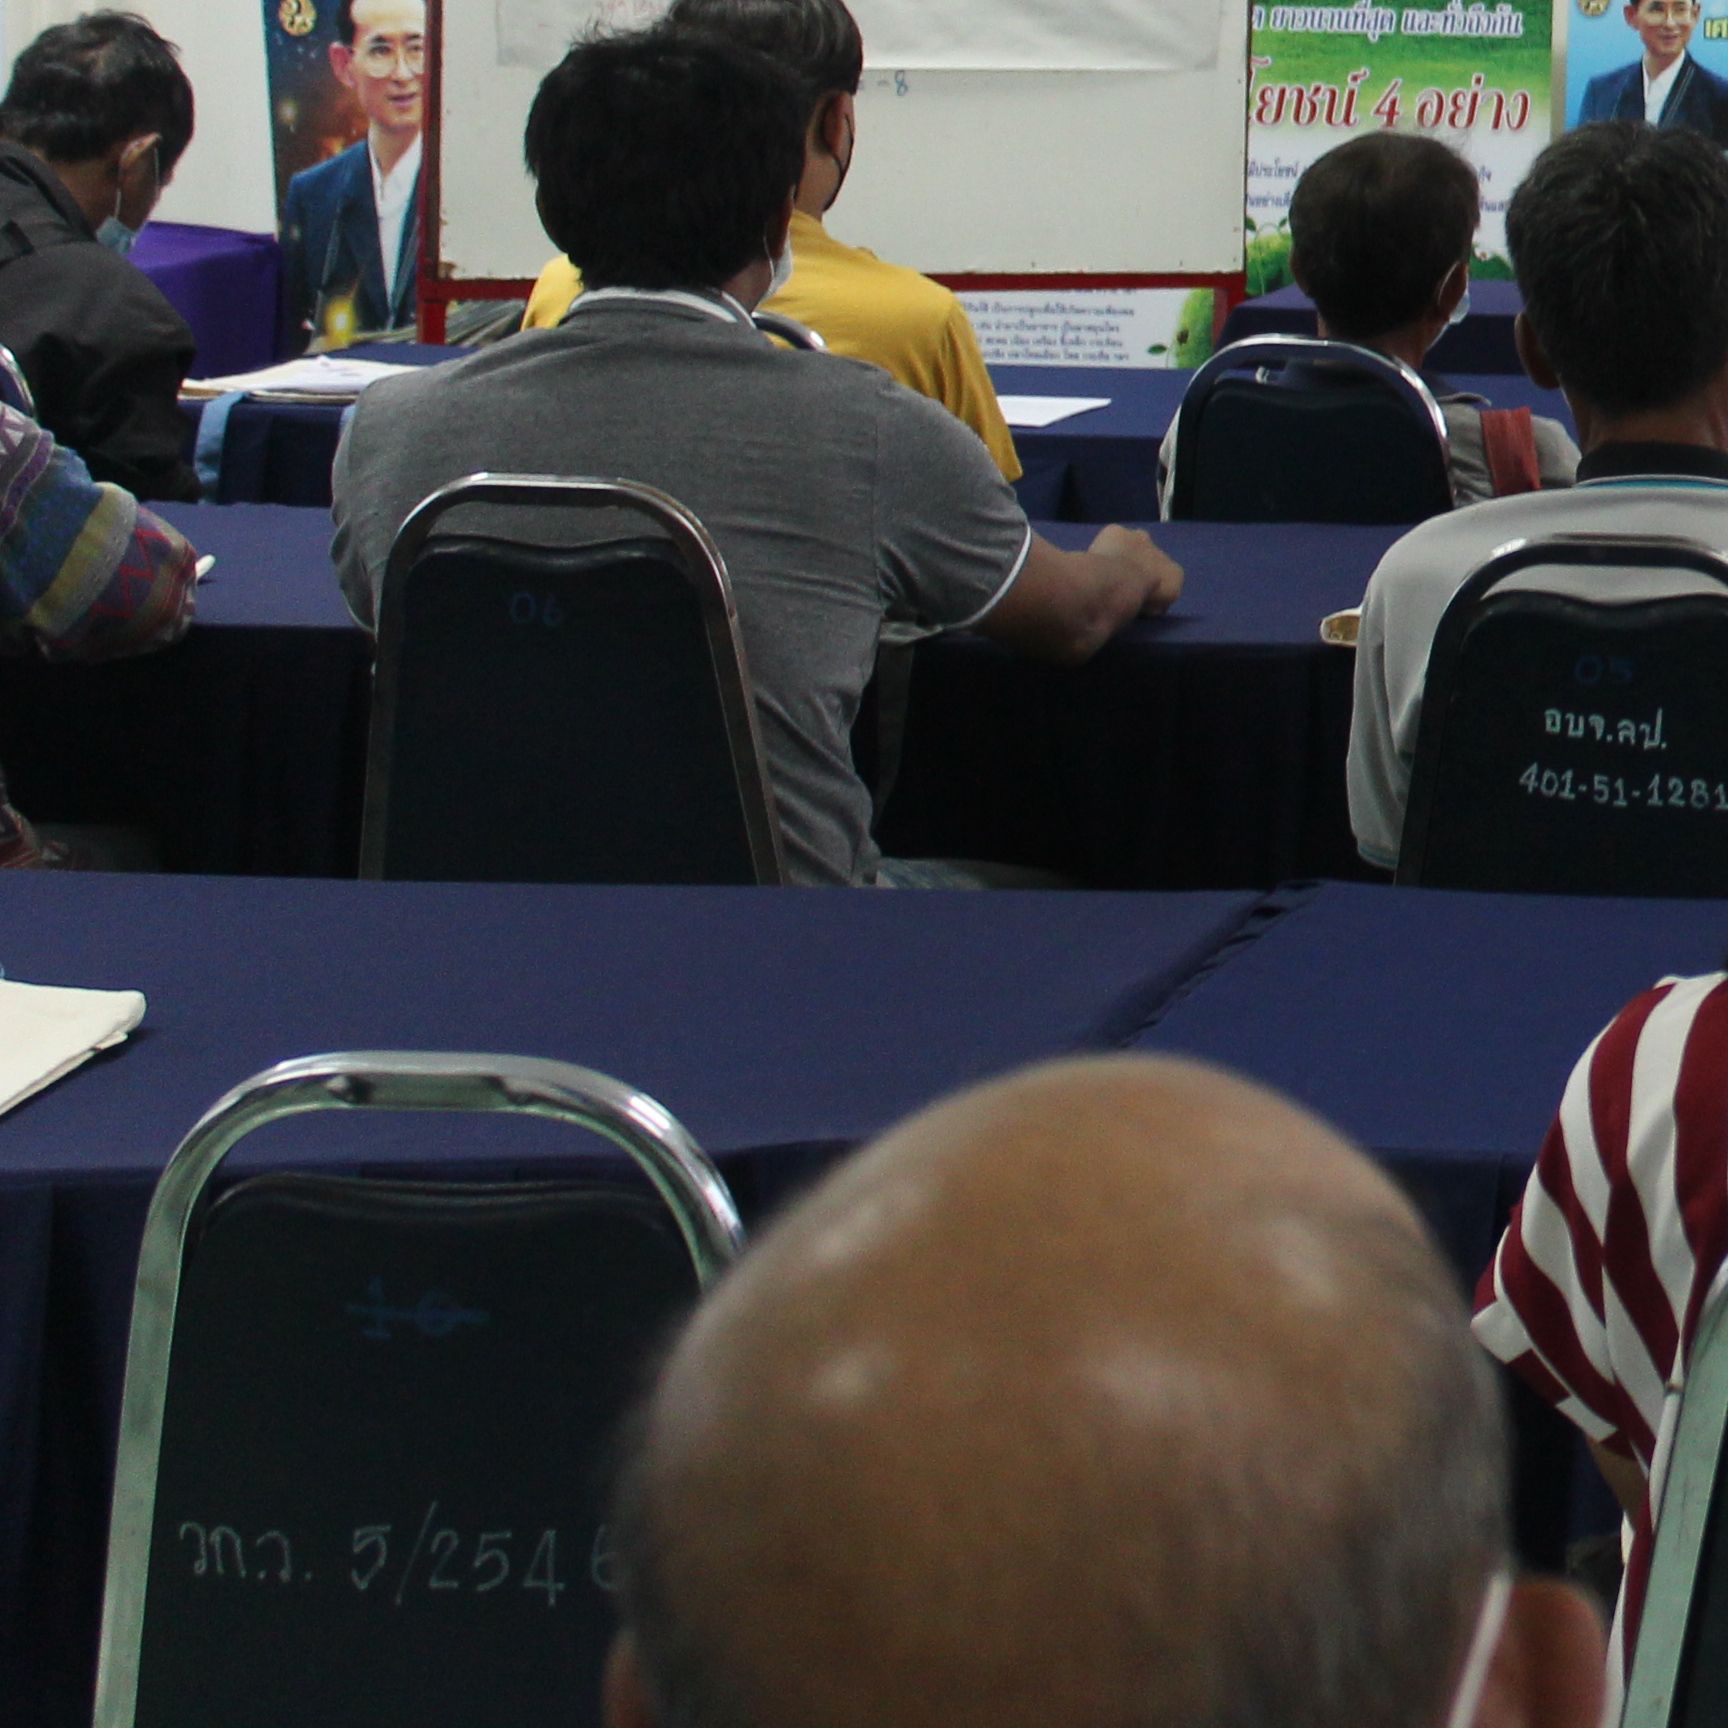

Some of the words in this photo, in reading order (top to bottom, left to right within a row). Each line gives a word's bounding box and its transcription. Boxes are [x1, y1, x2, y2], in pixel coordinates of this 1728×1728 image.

[1372, 77, 1402, 128] 4
[1415, 73, 1531, 131] อย่าง
[1544, 707, 1668, 751] อบจ.ลป.
